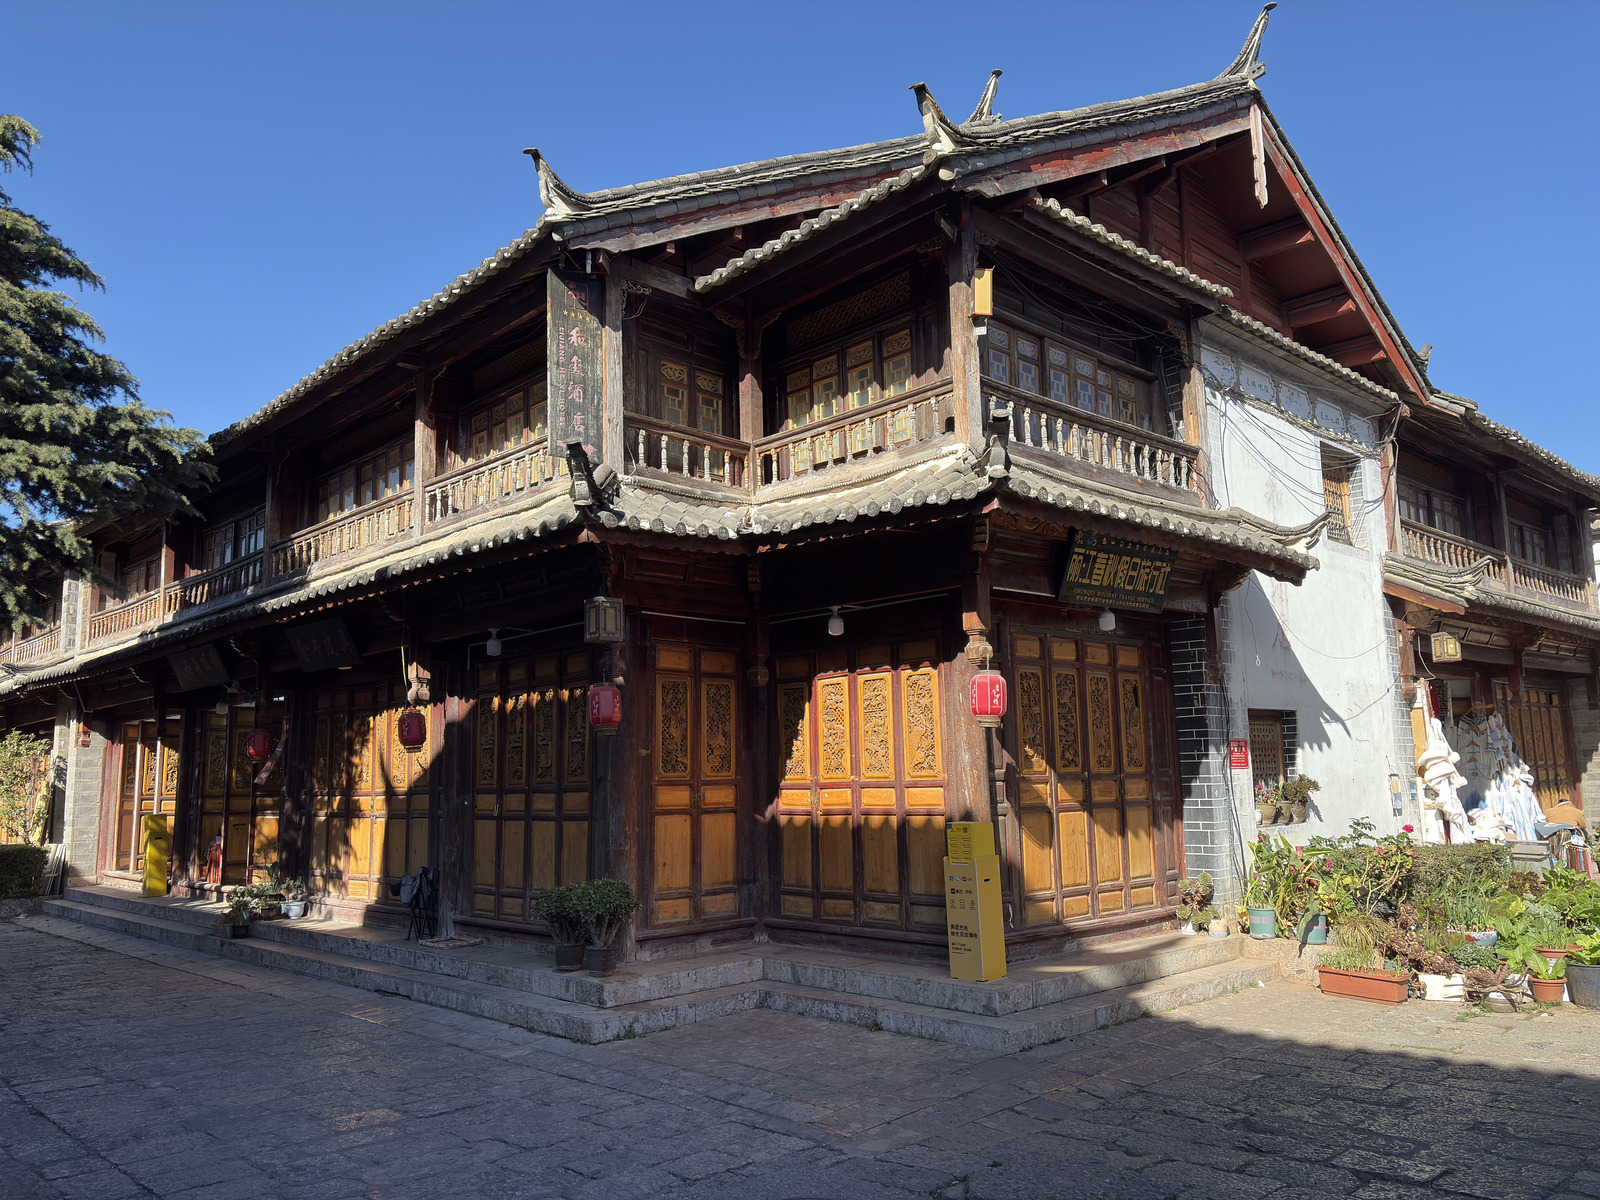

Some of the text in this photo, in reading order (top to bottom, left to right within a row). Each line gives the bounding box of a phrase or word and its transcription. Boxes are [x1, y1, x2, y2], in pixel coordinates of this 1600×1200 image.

[1066, 547, 1171, 595] 丽江春秋假日旅行社
